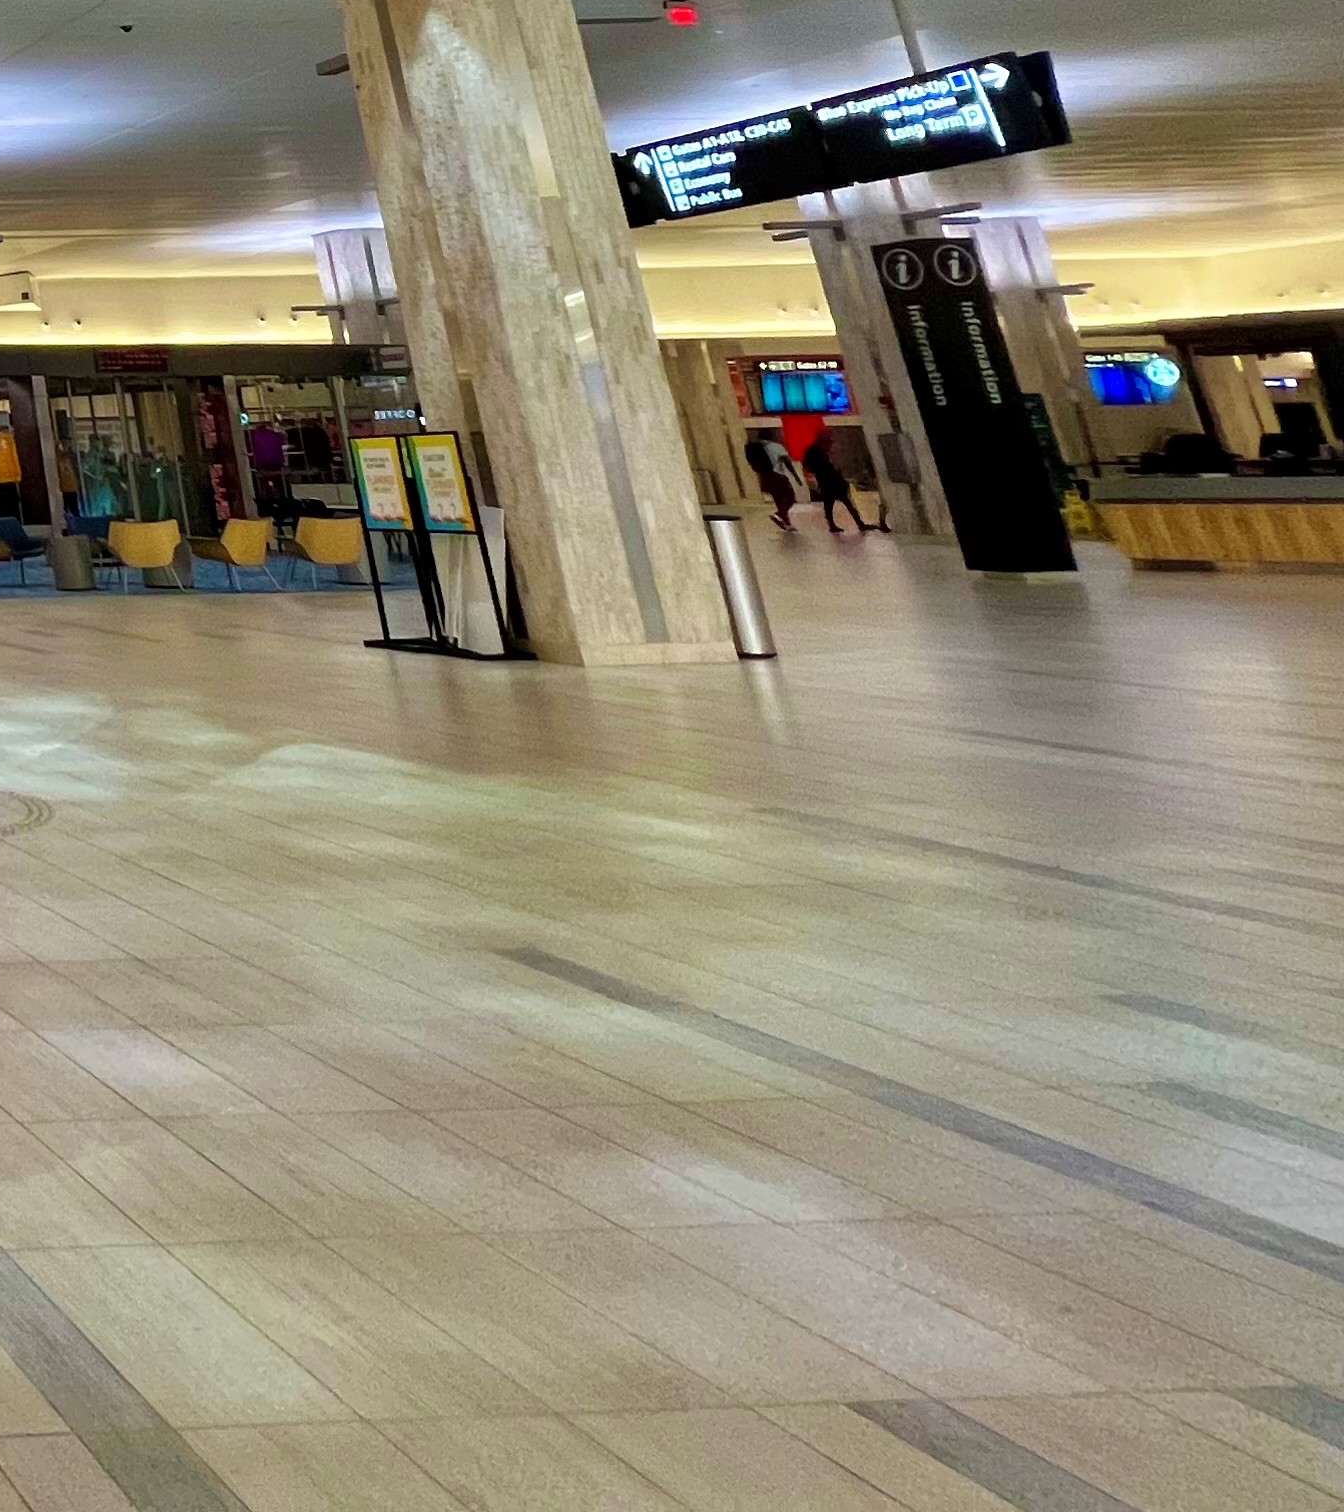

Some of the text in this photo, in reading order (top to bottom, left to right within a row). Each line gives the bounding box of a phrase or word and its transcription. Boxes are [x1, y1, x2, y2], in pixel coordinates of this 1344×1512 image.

[846, 93, 897, 114] Express
[885, 124, 926, 141] Long
[924, 114, 965, 132] Term
[689, 191, 723, 206] Public
[906, 304, 947, 406] Information
[959, 301, 1002, 404] Information
